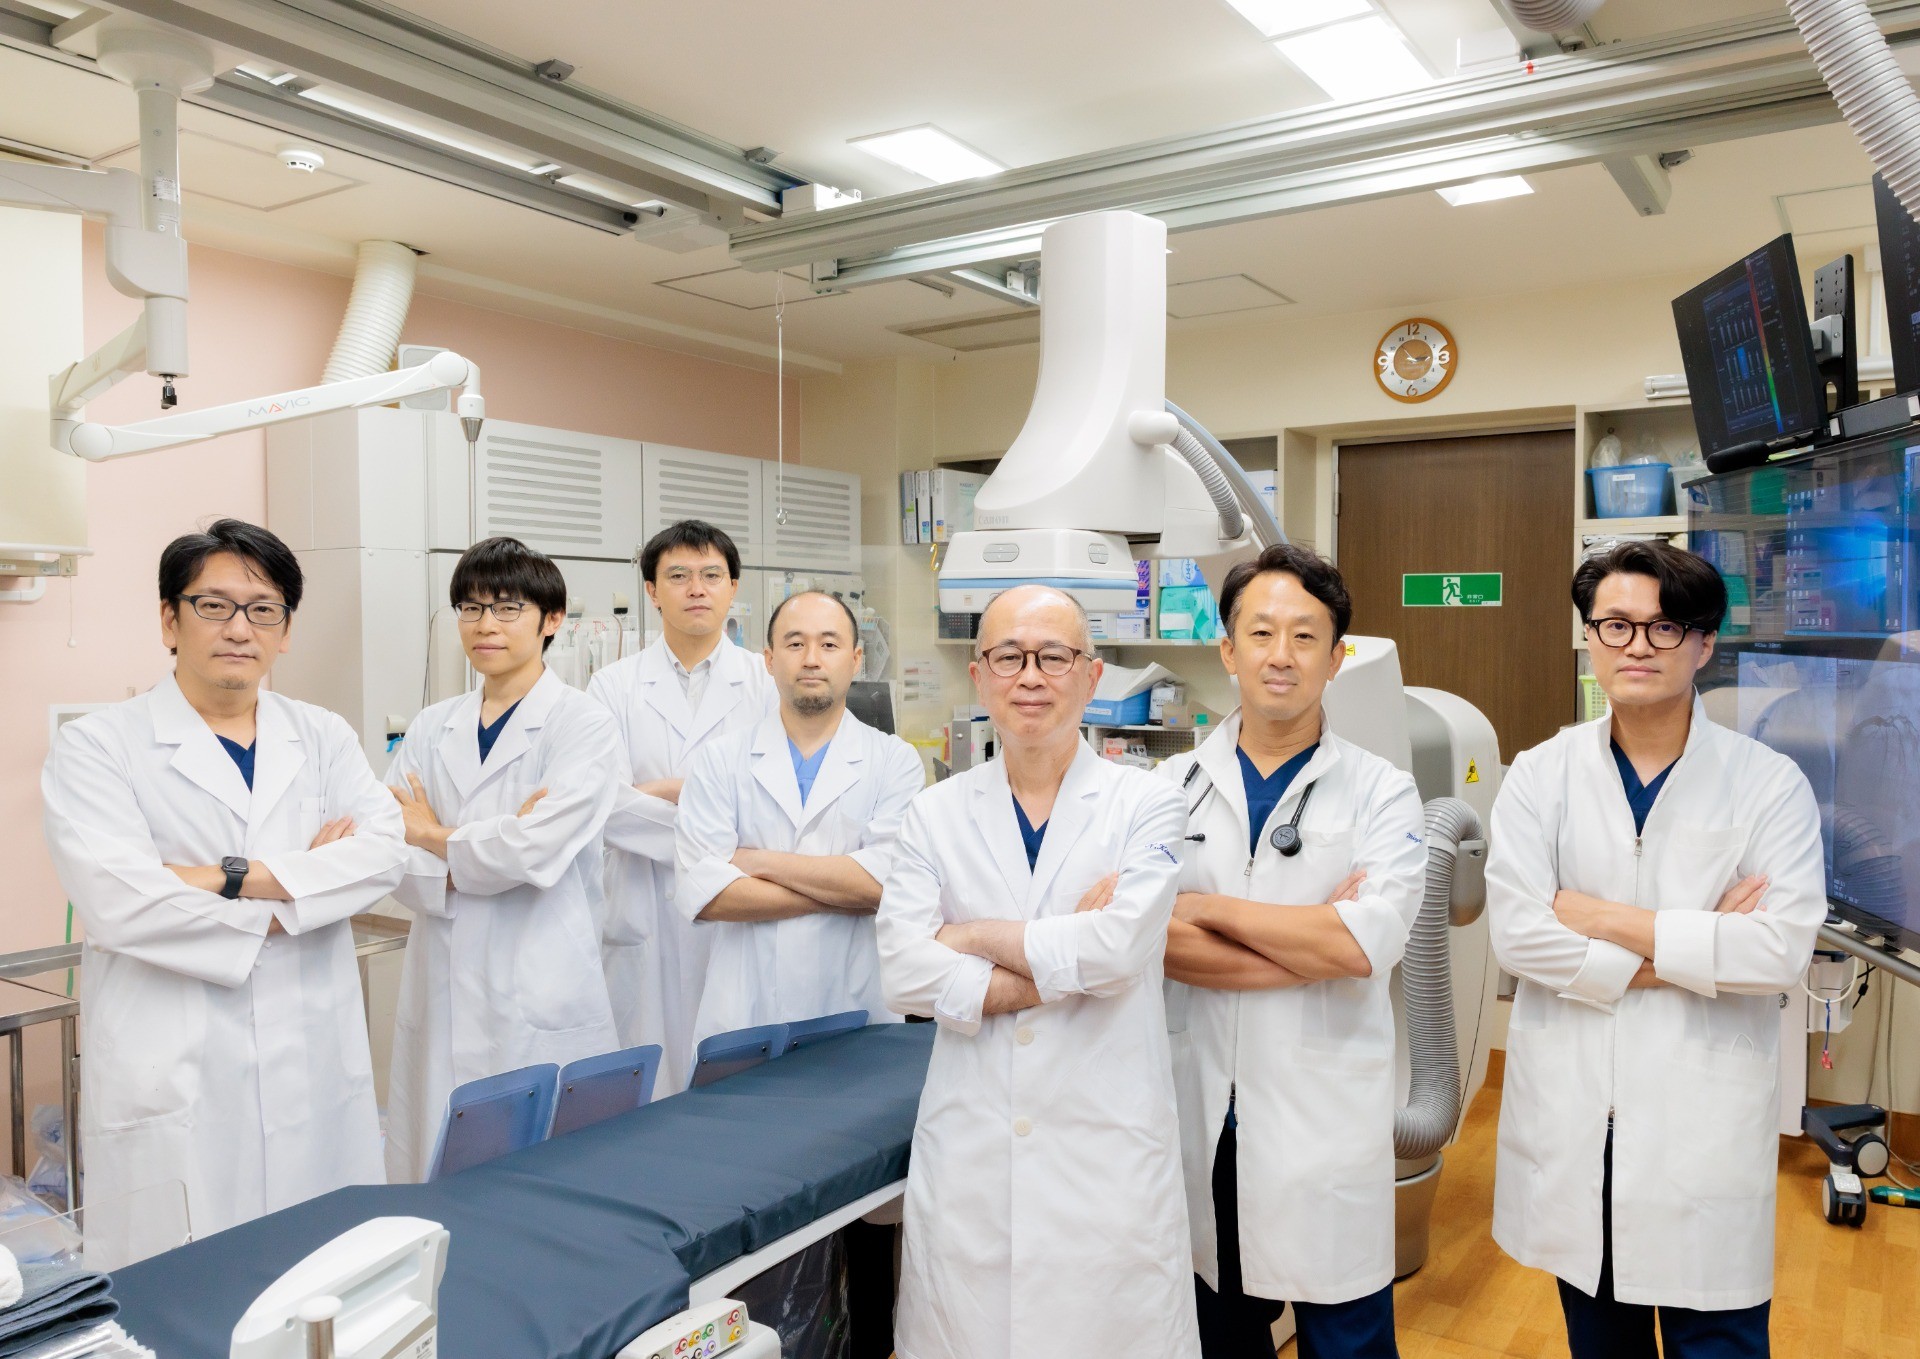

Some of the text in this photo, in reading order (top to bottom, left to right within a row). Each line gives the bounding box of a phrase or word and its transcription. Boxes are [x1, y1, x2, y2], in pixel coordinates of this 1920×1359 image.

[1407, 323, 1420, 336] 12
[1377, 355, 1389, 370] 9
[1438, 350, 1450, 366] 3
[1406, 384, 1418, 397] 6
[247, 396, 311, 418] MAVIG
